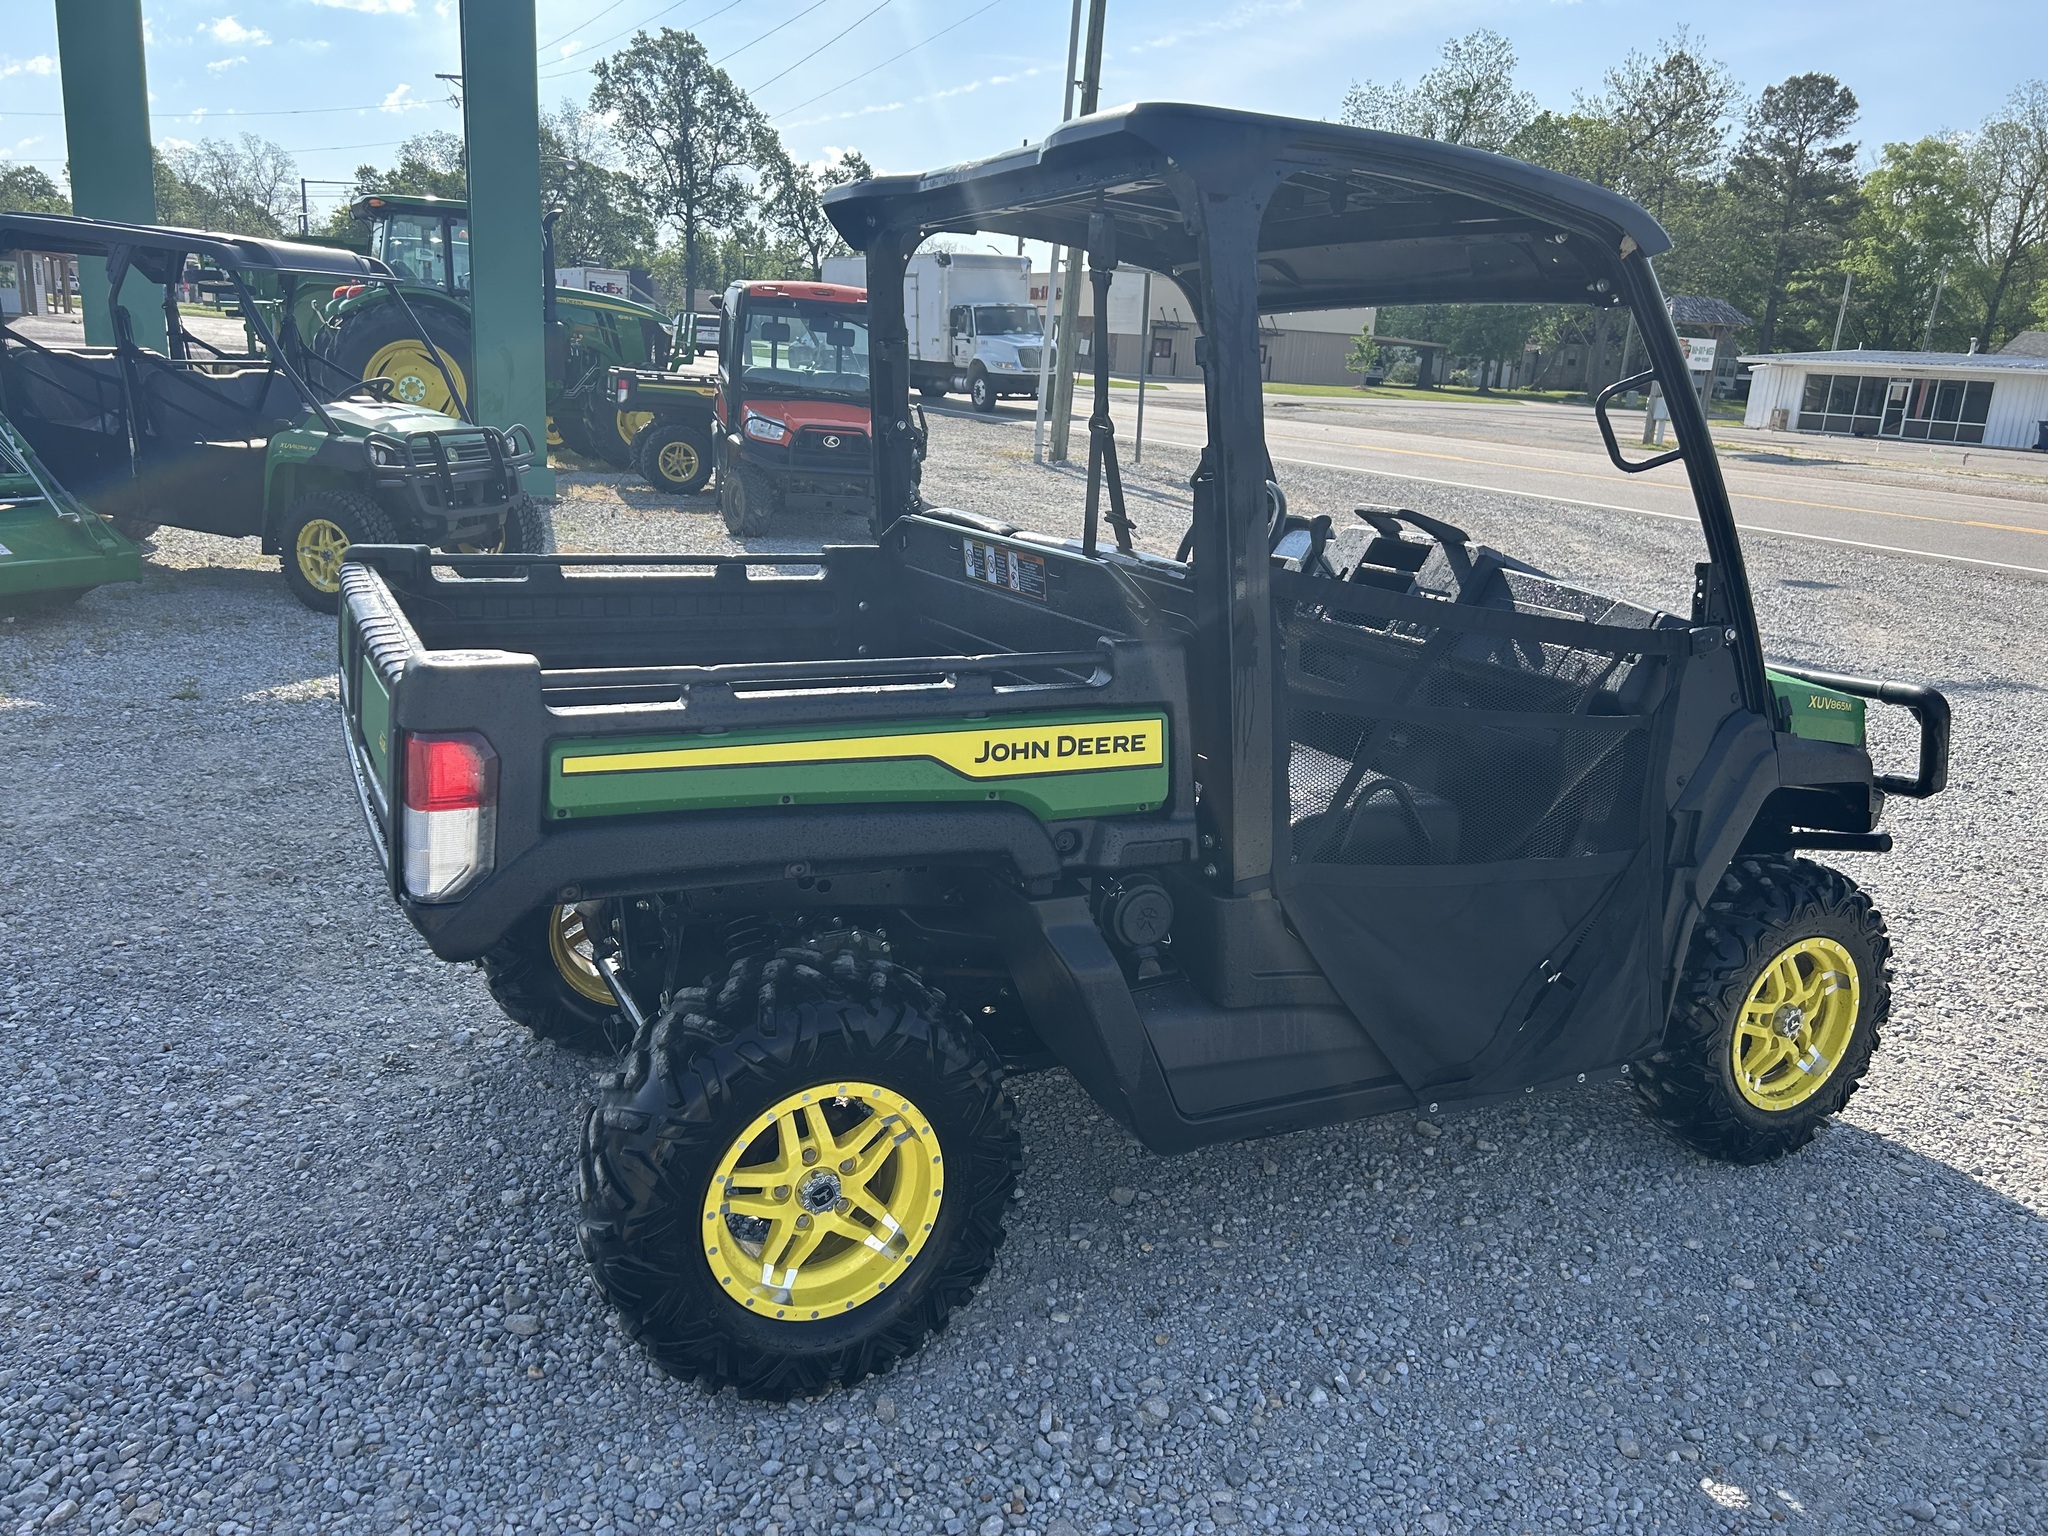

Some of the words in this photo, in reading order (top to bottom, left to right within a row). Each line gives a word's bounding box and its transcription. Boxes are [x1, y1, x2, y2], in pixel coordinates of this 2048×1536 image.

[589, 281, 623, 294] FedEx
[1808, 695, 1852, 711] XUV865M
[974, 740, 1050, 763] JOHN
[1057, 734, 1146, 757] DEERE
